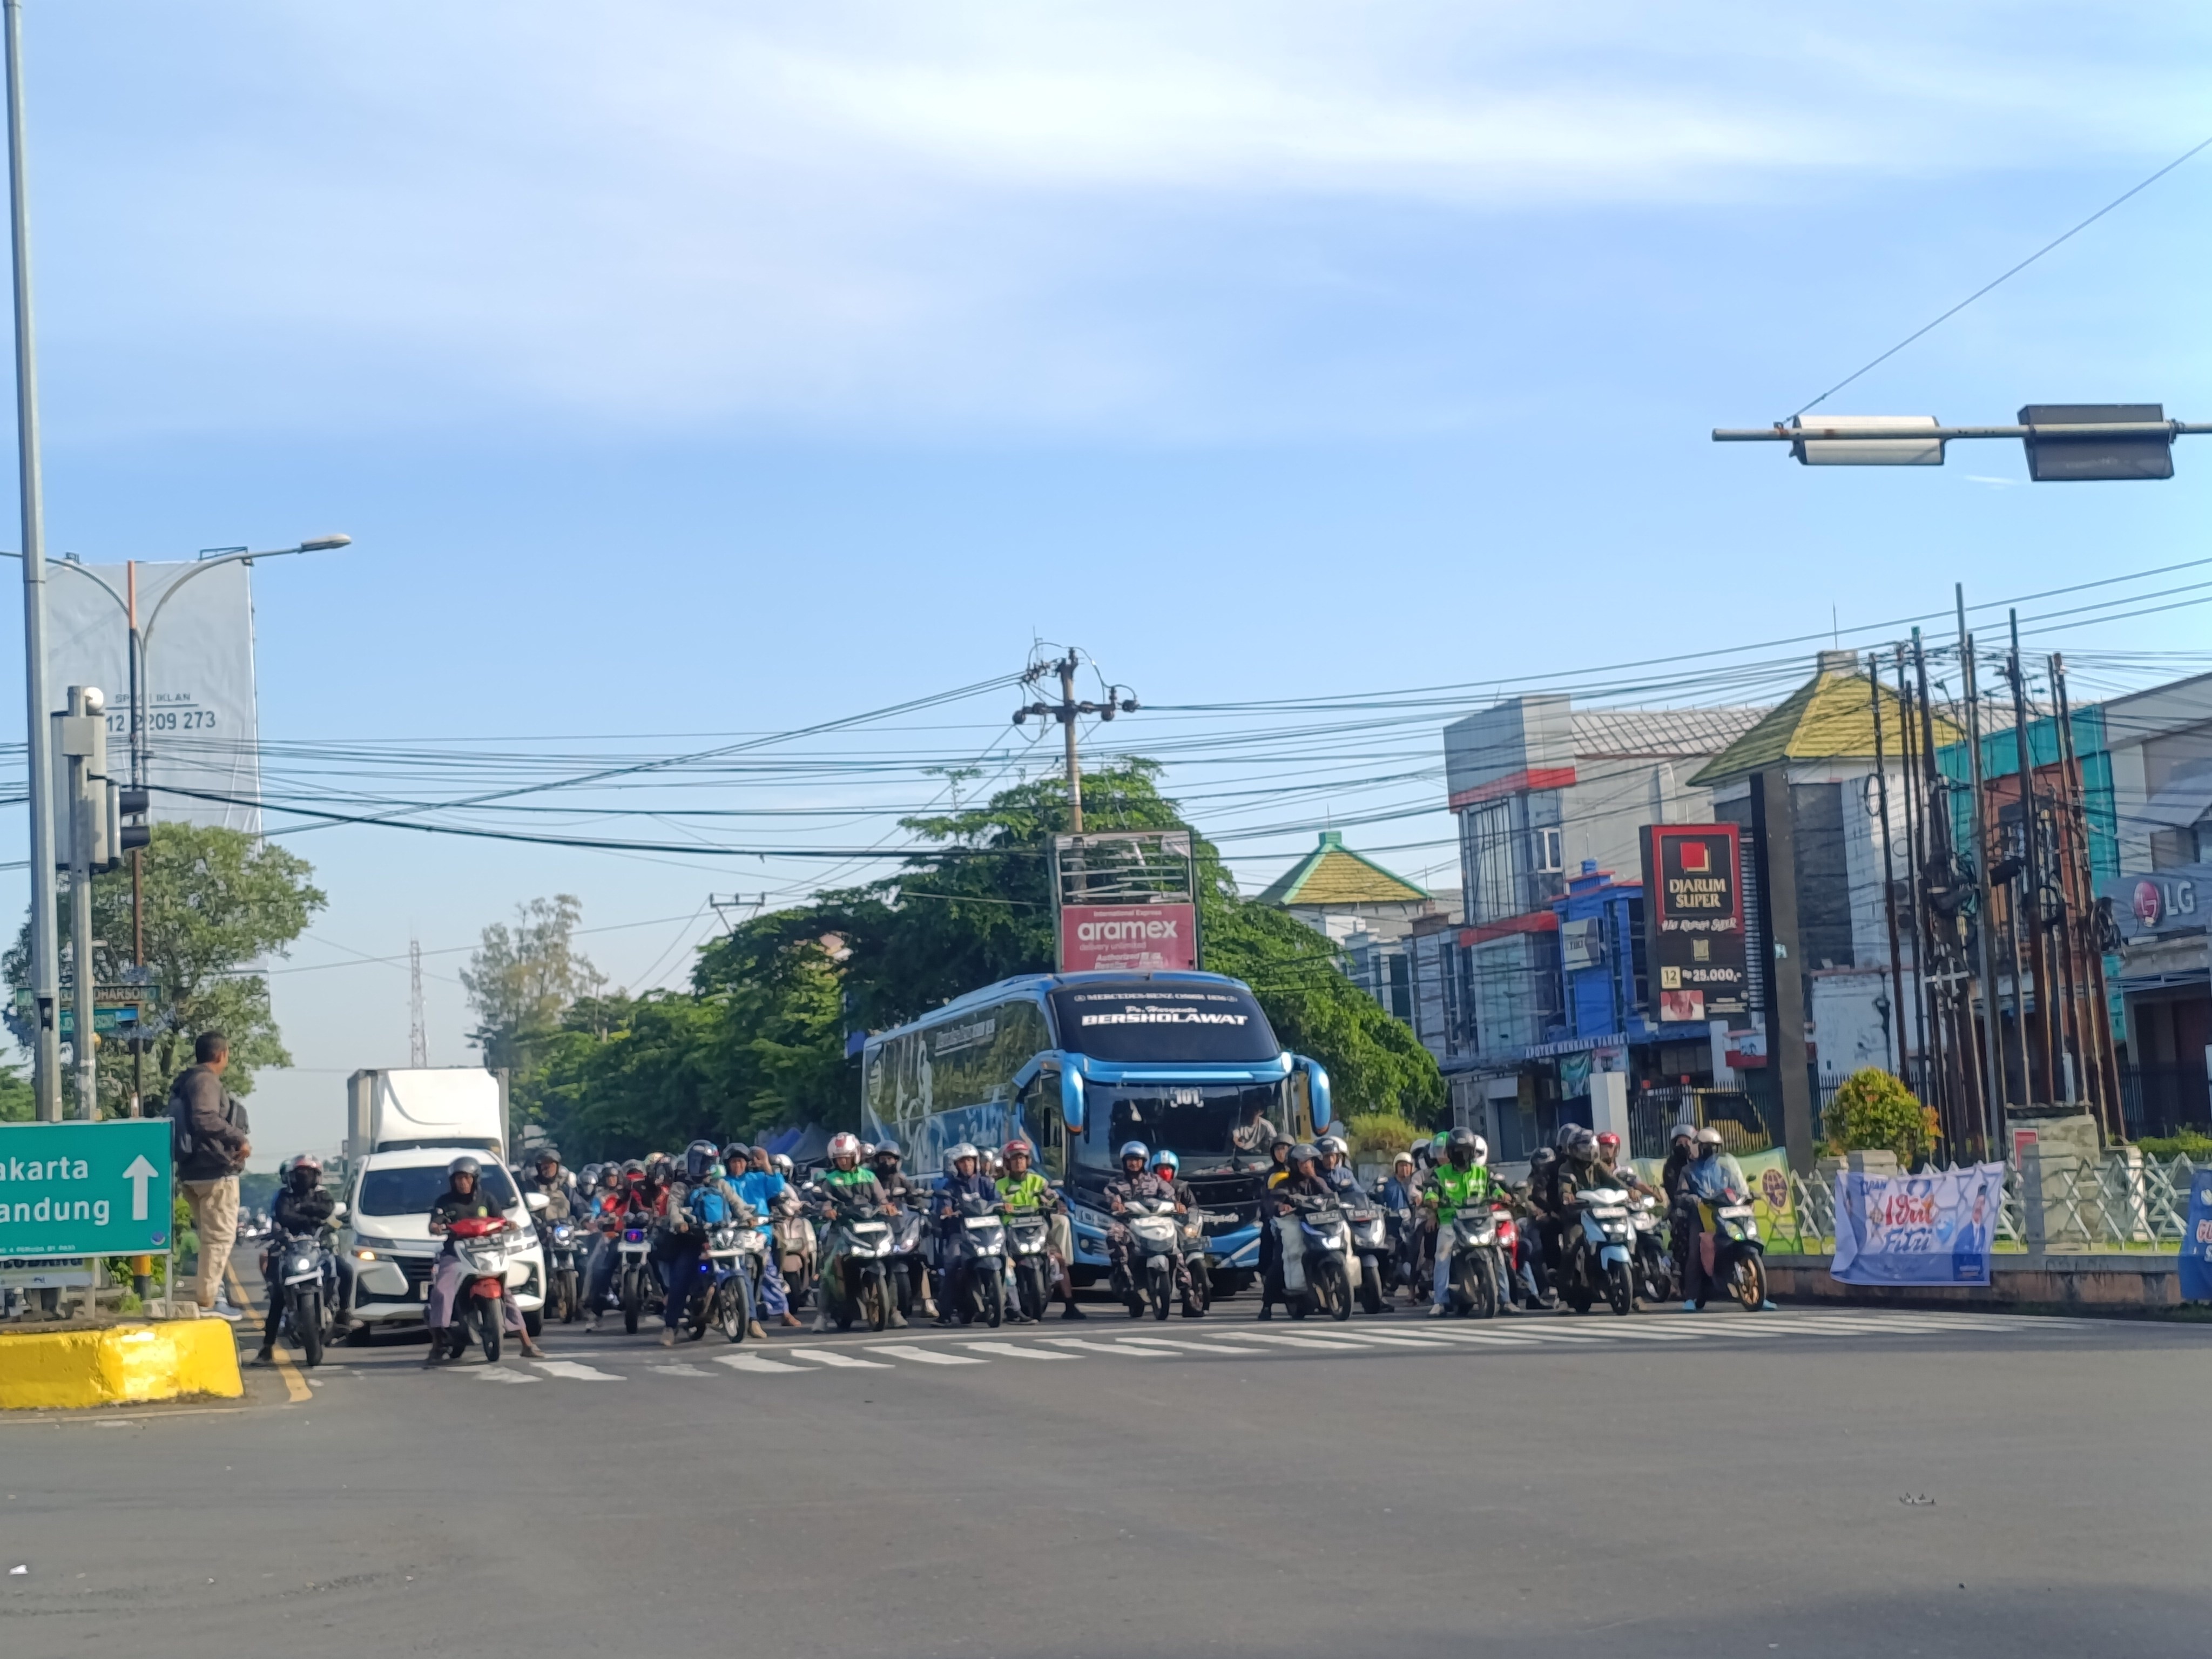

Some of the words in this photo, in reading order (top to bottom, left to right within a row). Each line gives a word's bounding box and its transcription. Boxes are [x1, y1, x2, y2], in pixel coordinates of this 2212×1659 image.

[184, 711, 216, 729] 273
[1669, 878, 1727, 893] DJARUM
[1676, 893, 1721, 908] SUPER
[2164, 880, 2194, 916] LG
[1077, 920, 1178, 941] aramex
[1082, 1013, 1248, 1026] BERSHOLAWAT
[1174, 1089, 1199, 1105] 101
